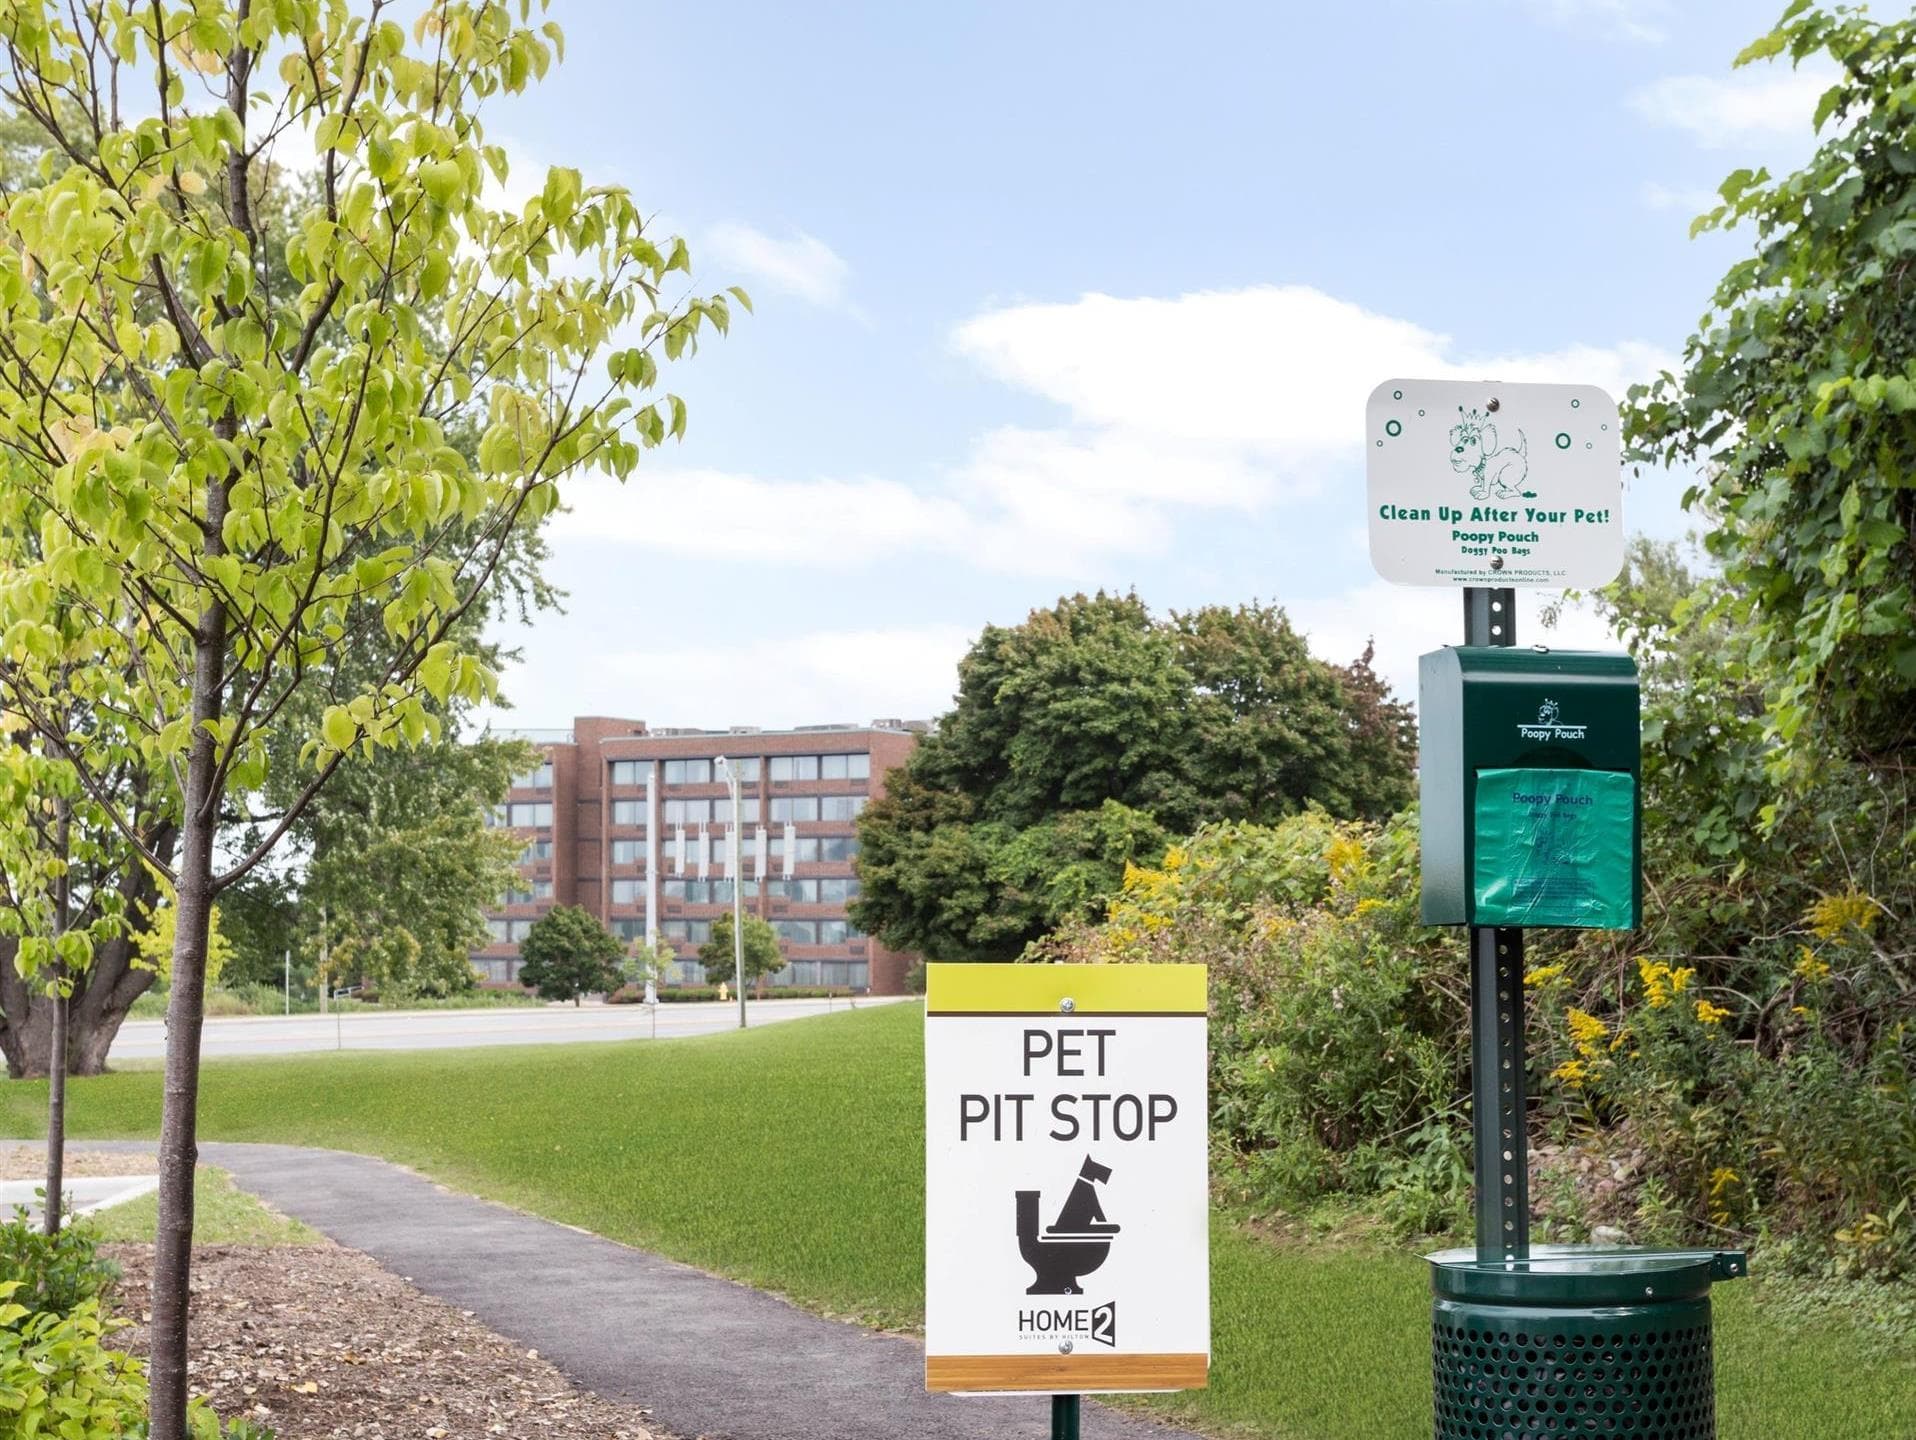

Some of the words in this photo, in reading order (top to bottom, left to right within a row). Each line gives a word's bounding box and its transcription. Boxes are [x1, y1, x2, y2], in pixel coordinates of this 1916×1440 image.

[1379, 505, 1430, 521] Clean
[1438, 506, 1463, 524] Up
[1470, 507, 1518, 522] After
[1525, 508, 1567, 523] Your
[1574, 509, 1610, 523] Pet!
[1452, 530, 1494, 544] Poopy
[1498, 531, 1539, 542] Pouch
[1461, 546, 1488, 556] Doggy
[1512, 547, 1530, 556] Bags
[1521, 728, 1551, 741] Poopy
[1555, 729, 1584, 739] Pouch
[1512, 792, 1551, 806] Poopy
[1555, 794, 1593, 805] Pouch
[1023, 1029, 1116, 1076] PET
[960, 1094, 1034, 1141] PIT
[1049, 1094, 1178, 1141] STOP
